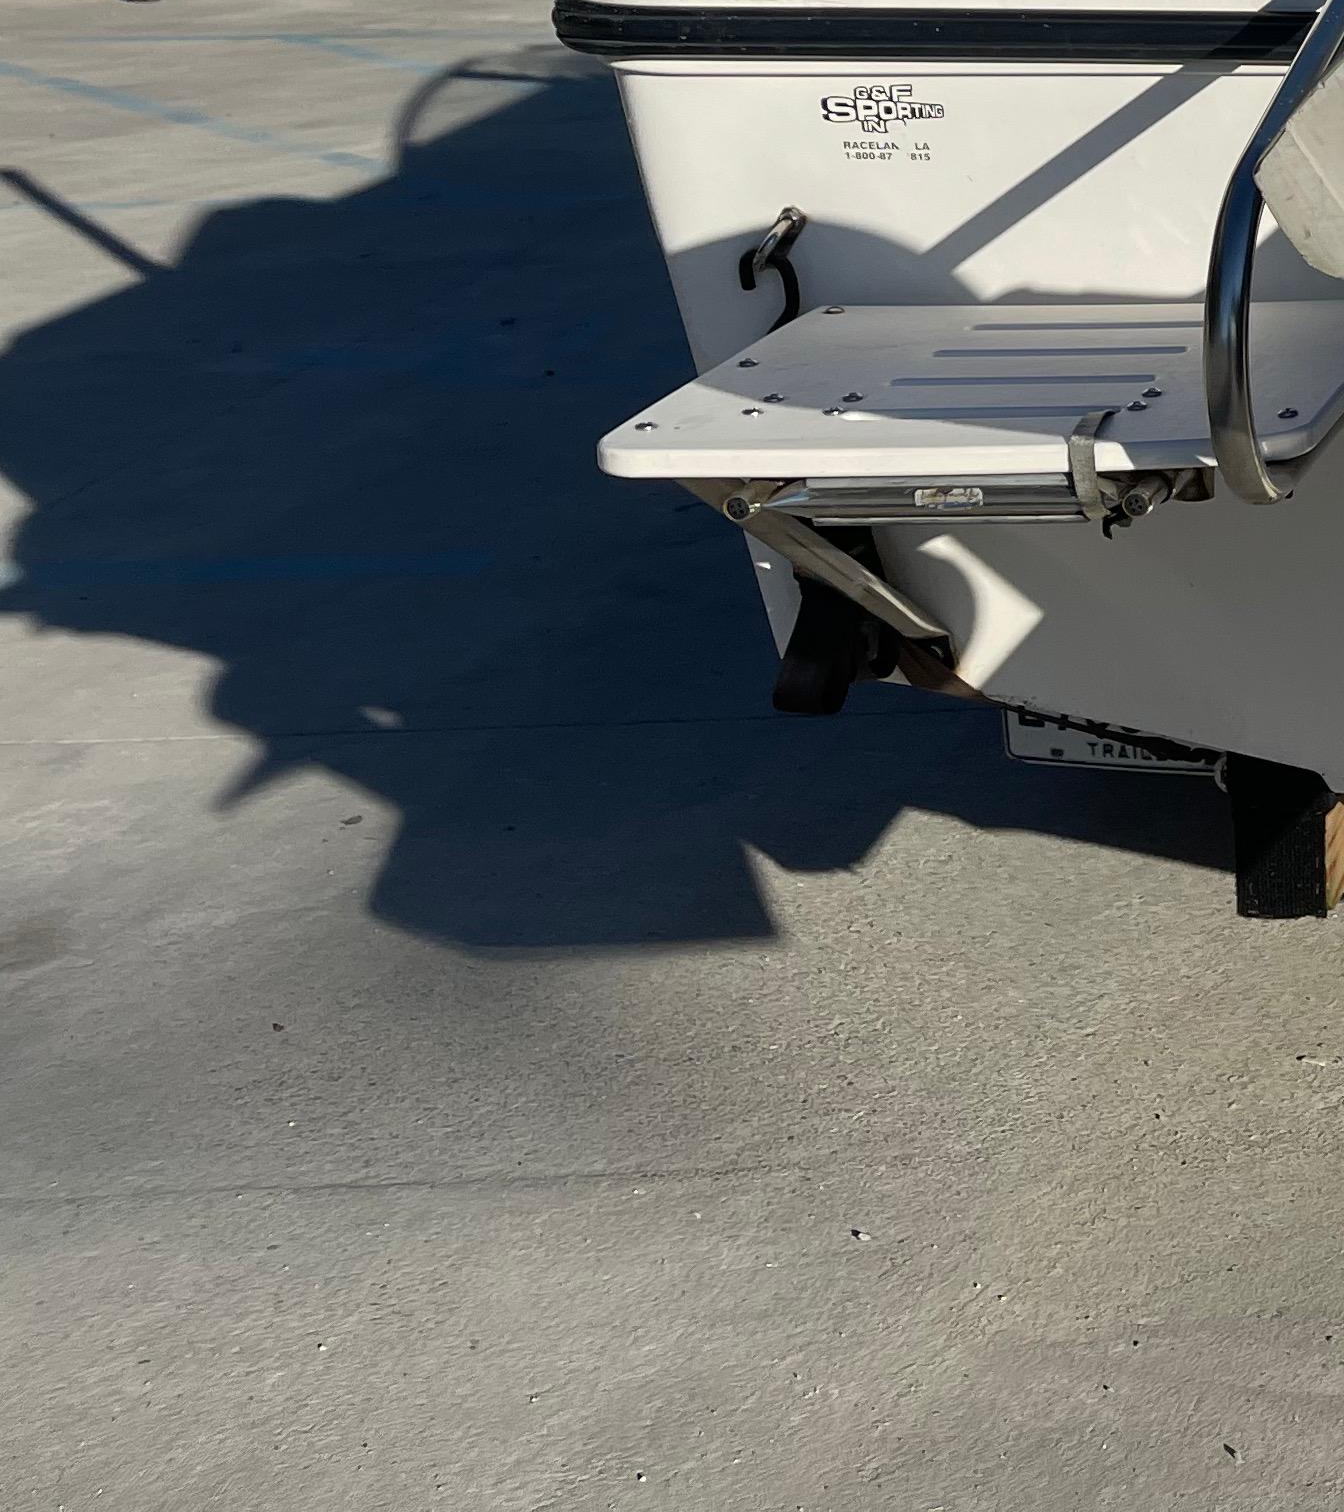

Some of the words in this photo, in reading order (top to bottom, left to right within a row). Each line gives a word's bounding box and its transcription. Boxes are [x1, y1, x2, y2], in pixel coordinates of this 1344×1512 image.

[853, 84, 912, 102] G&F
[821, 96, 944, 123] SPORTING
[914, 142, 930, 151] LA
